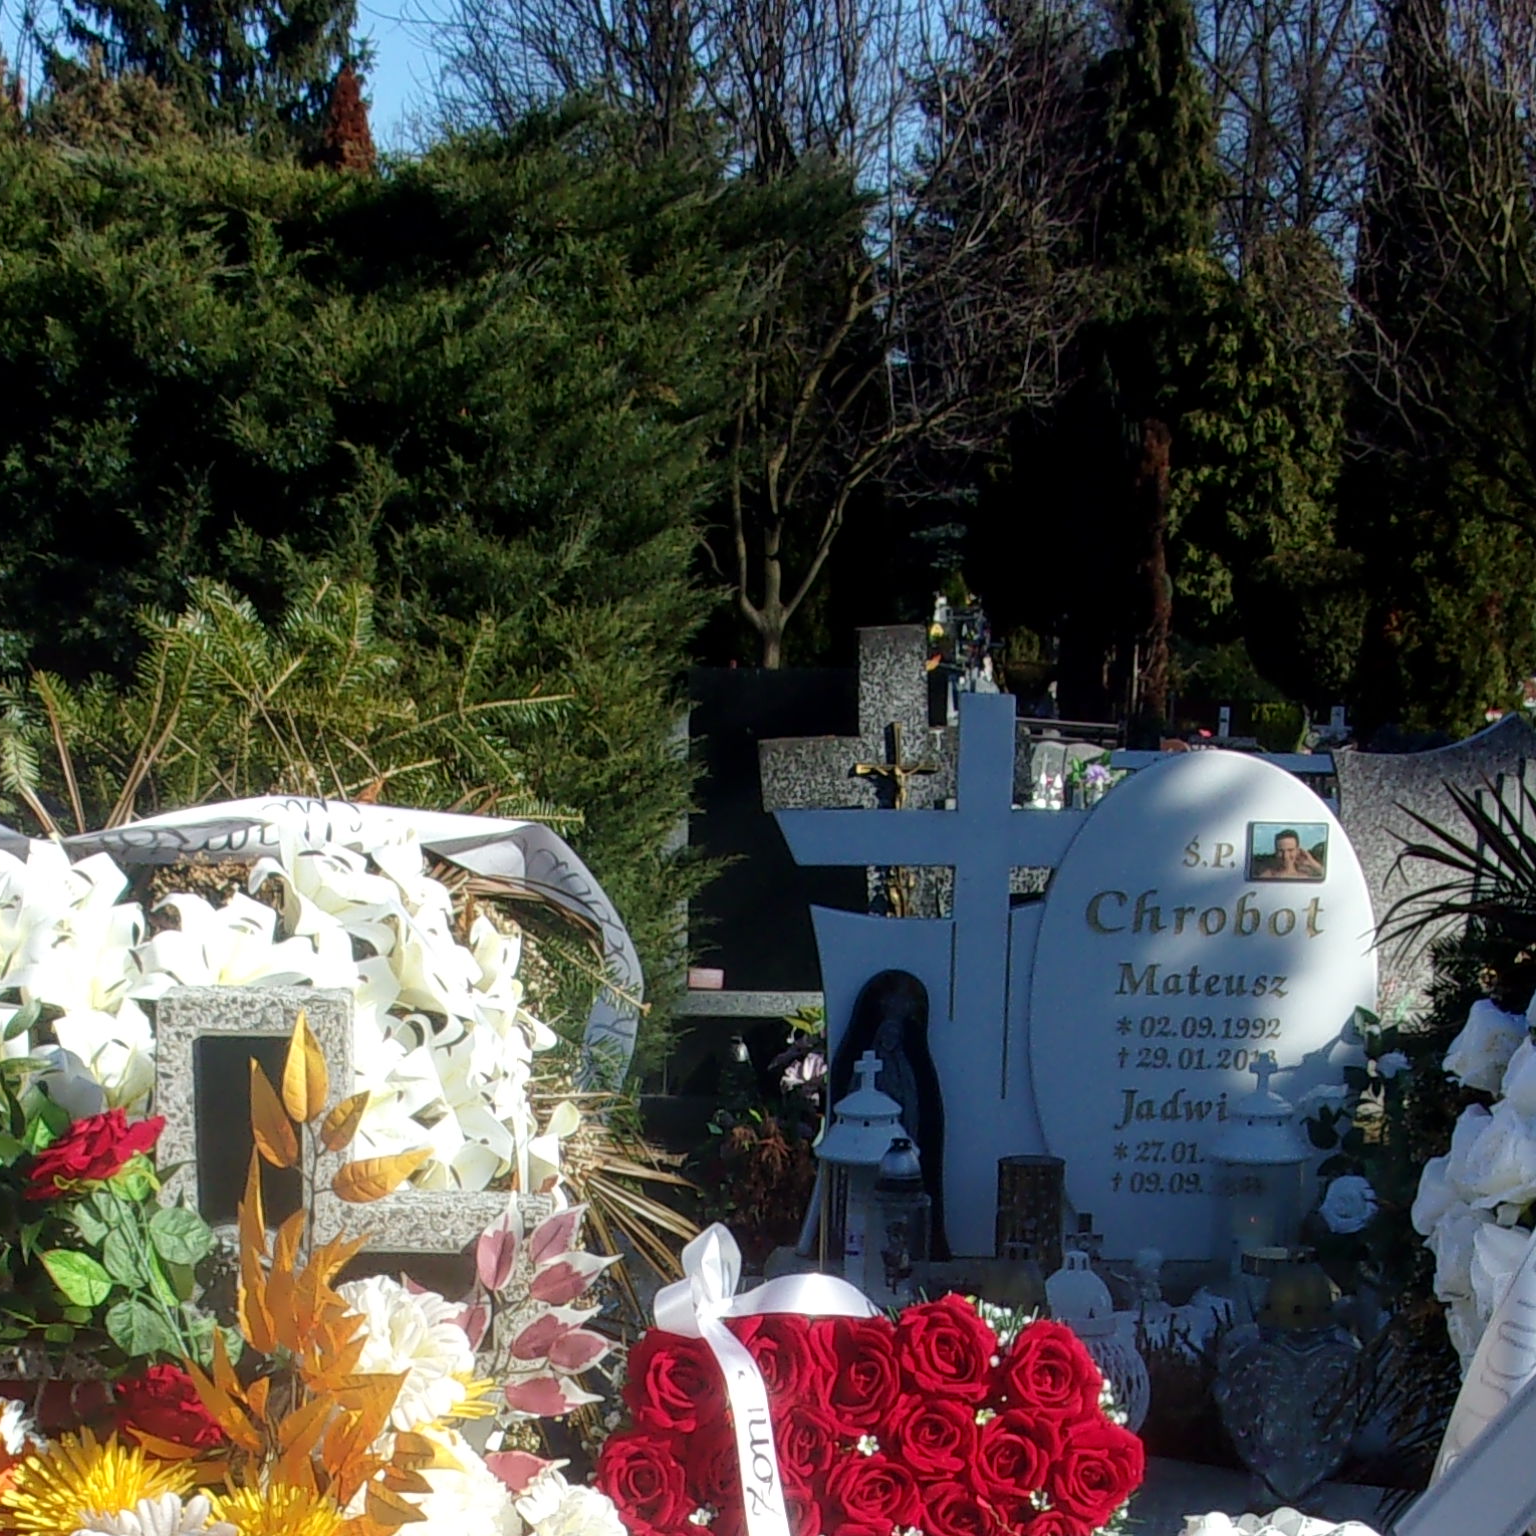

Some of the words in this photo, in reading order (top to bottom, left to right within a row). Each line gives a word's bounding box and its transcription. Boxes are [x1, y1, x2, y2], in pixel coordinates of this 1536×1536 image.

[1182, 835, 1236, 869] Ś.P.
[1085, 889, 1325, 938] Chrobot
[1115, 962, 1289, 998] Mateusz
[1140, 1016, 1282, 1039] 02.09.1992
[1114, 1088, 1230, 1130] Jadwi
